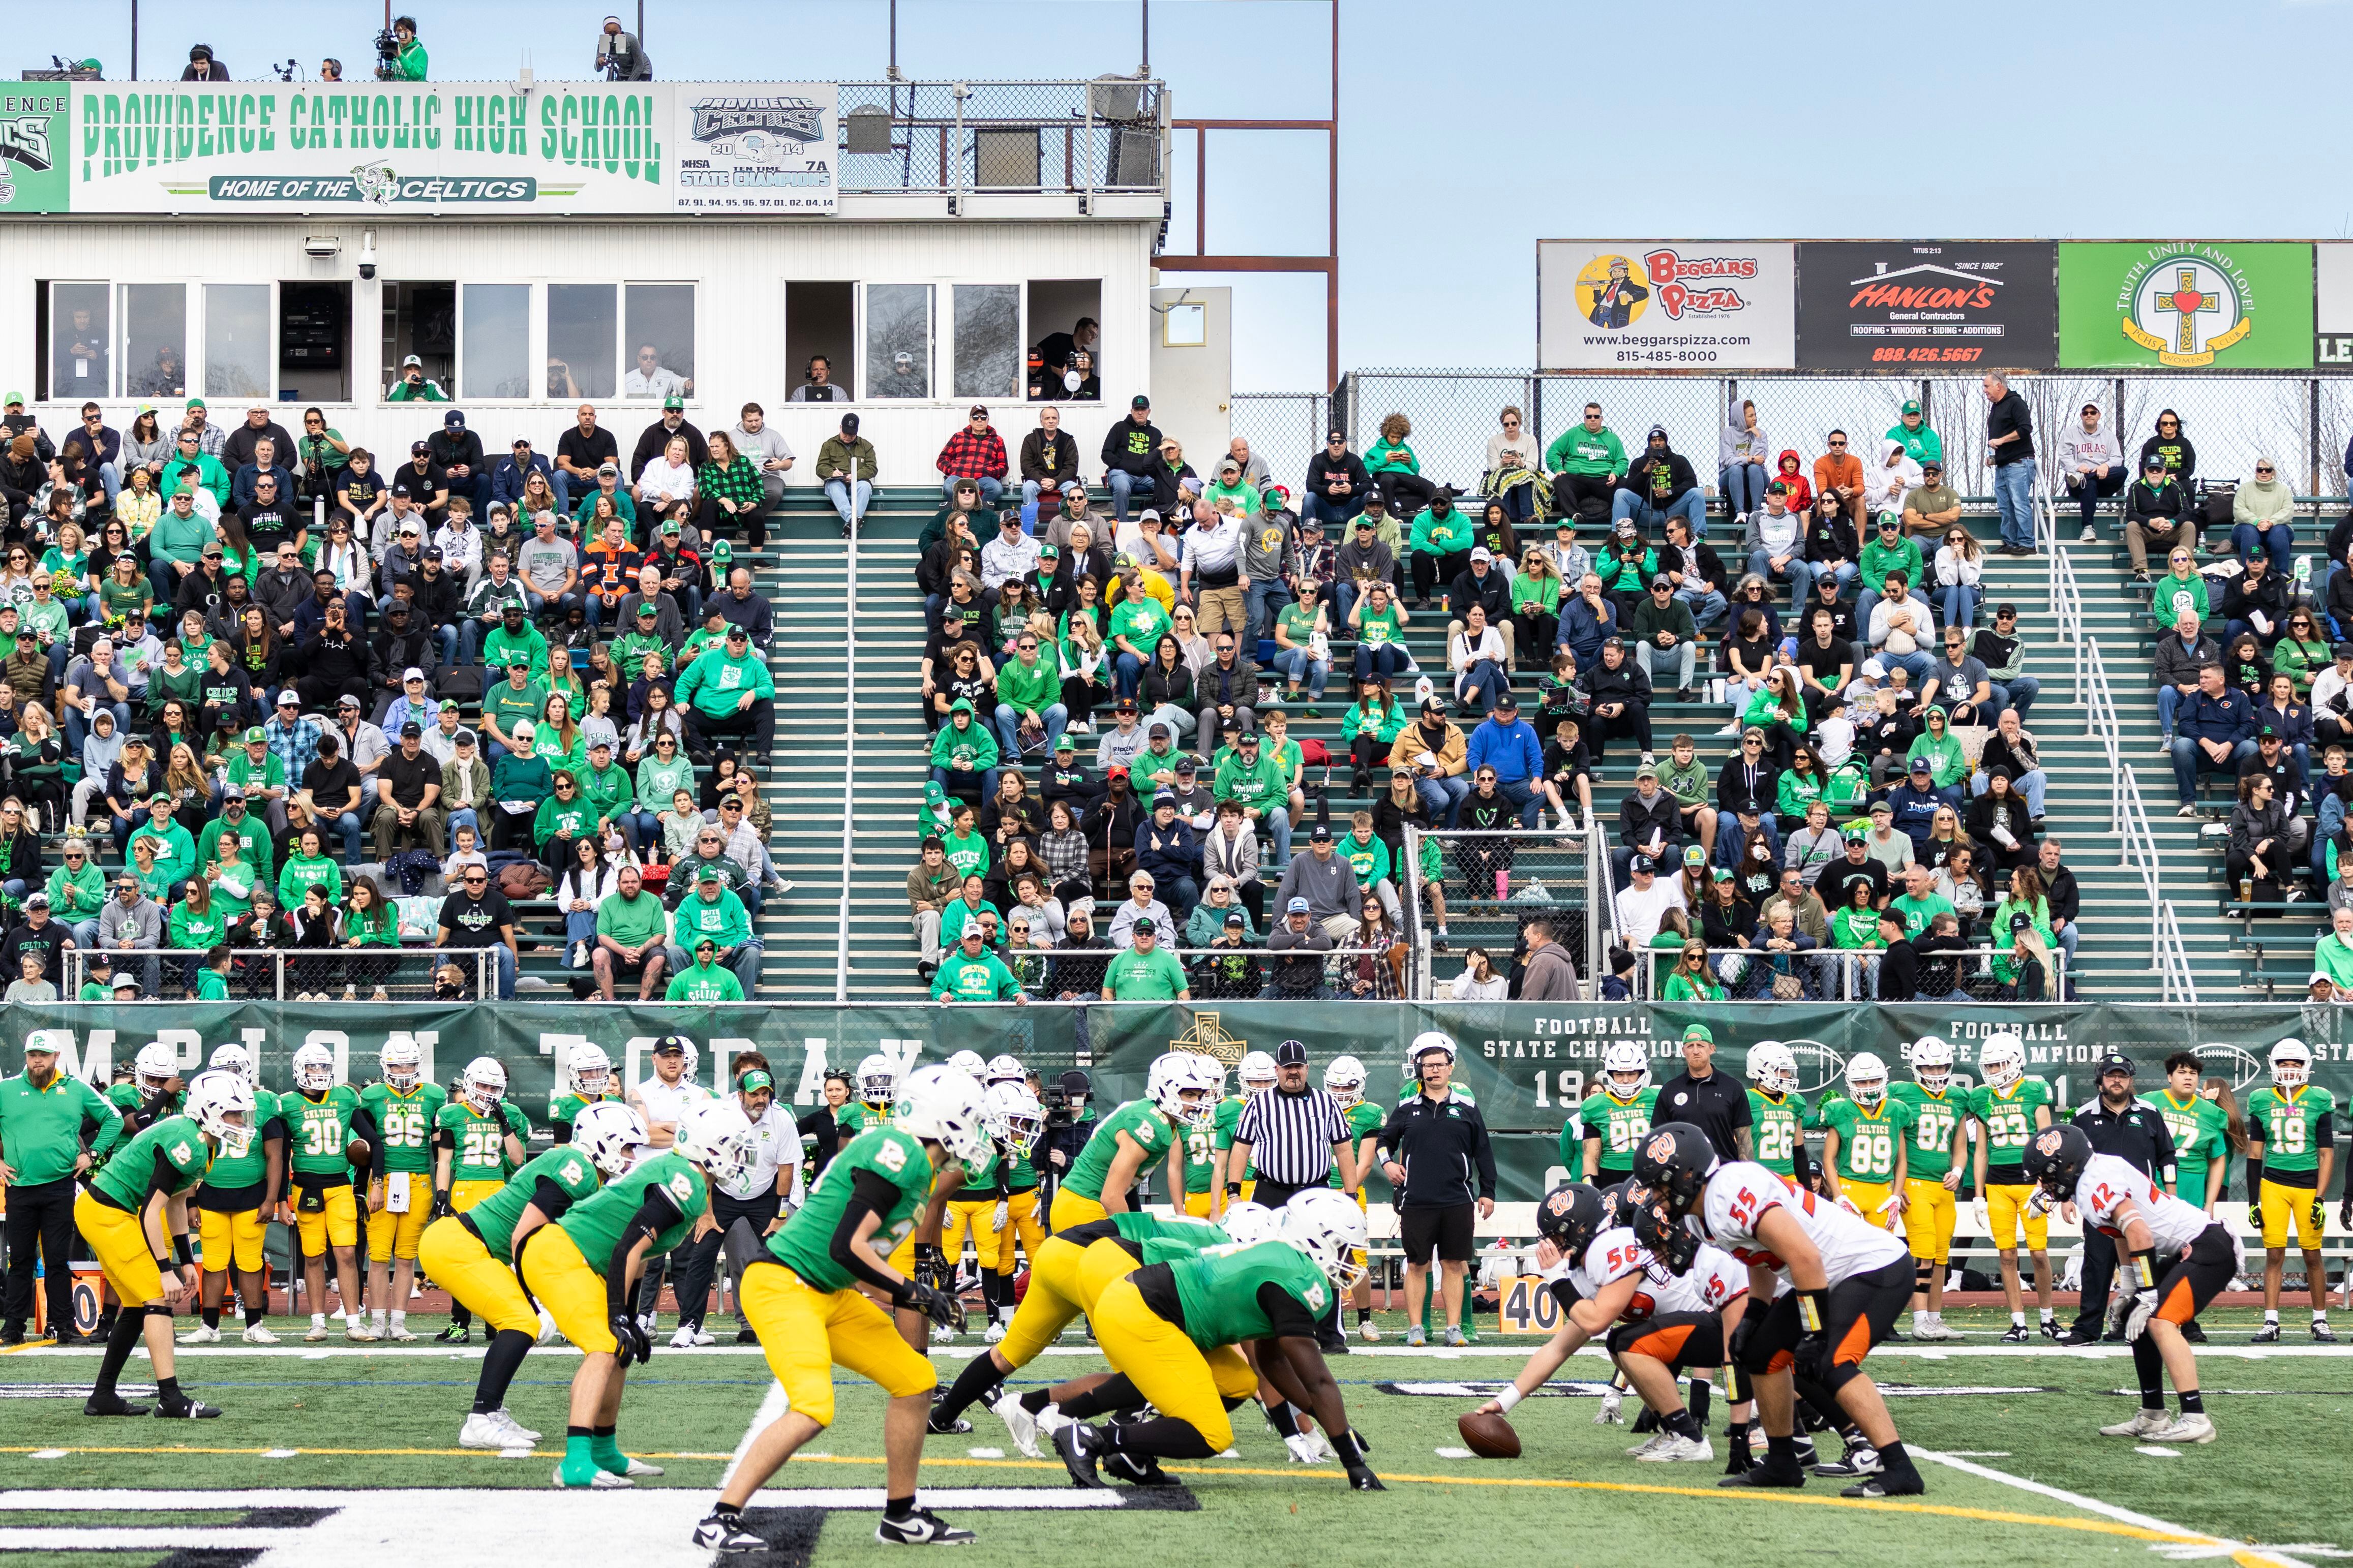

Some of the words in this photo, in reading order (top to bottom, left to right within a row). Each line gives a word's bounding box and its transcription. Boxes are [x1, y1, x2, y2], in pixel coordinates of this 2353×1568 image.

[697, 98, 814, 109] PROVIDENCE
[693, 109, 821, 138] CELTICS
[83, 93, 275, 182] PROVIDENCE
[290, 95, 441, 149] CATHOLIC
[455, 95, 527, 156] HIGH
[541, 95, 660, 186] SCHOOL
[711, 143, 733, 155] 20
[783, 143, 804, 155] 14
[681, 171, 730, 187] STATE
[733, 171, 831, 187] CHAMPIONS
[218, 181, 281, 197] HOME
[282, 181, 309, 197] OF
[311, 181, 353, 197] THE
[402, 181, 527, 198] CELTICS
[2148, 243, 2198, 262] UNITY
[2201, 246, 2233, 270] AND
[2231, 268, 2255, 311] LOVE!
[1850, 283, 1995, 309] HANLON'S
[1890, 312, 1919, 320] General
[1920, 312, 1965, 320] Contractors
[1853, 326, 1885, 334] ROOFING
[1891, 326, 1927, 334] WINDOWS
[1933, 326, 1957, 334] SIDING
[1963, 326, 2002, 334] ADDITIONS
[1584, 334, 1751, 347] www.beggarspizza.com
[2132, 329, 2157, 348] PCHS
[2219, 331, 2241, 347] CLUB
[1617, 351, 1717, 362] 815-485-8000
[1872, 348, 1982, 362] 888.426.5667
[2164, 354, 2211, 364] WOMEN'S
[2076, 443, 2106, 455] LORAS
[1908, 801, 1940, 810] TITANS
[1535, 1017, 1652, 1035] FOOTBALL
[1951, 1021, 2067, 1041] FOOTBALL
[1484, 1040, 1556, 1058] STATE
[1570, 1040, 1686, 1058] CHAPION
[305, 1109, 337, 1118] CELTICS
[1610, 1110, 1644, 1120] CELTICS
[1764, 1111, 1794, 1120] CELTICS
[1921, 1103, 1952, 1114] CELTICS
[2163, 1112, 2196, 1127] CELTICS
[383, 1113, 425, 1147] 96
[467, 1124, 500, 1132] CELTICS
[1856, 1125, 1889, 1134] CELTICS
[1917, 1114, 1956, 1152] 87
[2270, 1118, 2306, 1154] 19
[302, 1118, 342, 1155] 30
[1759, 1121, 1795, 1160] 26
[1851, 1134, 1892, 1175] 89
[2091, 1183, 2115, 1214] 42
[1729, 1186, 1757, 1228] 55
[1607, 1244, 1639, 1274] 56
[1505, 1281, 1560, 1331] 40
